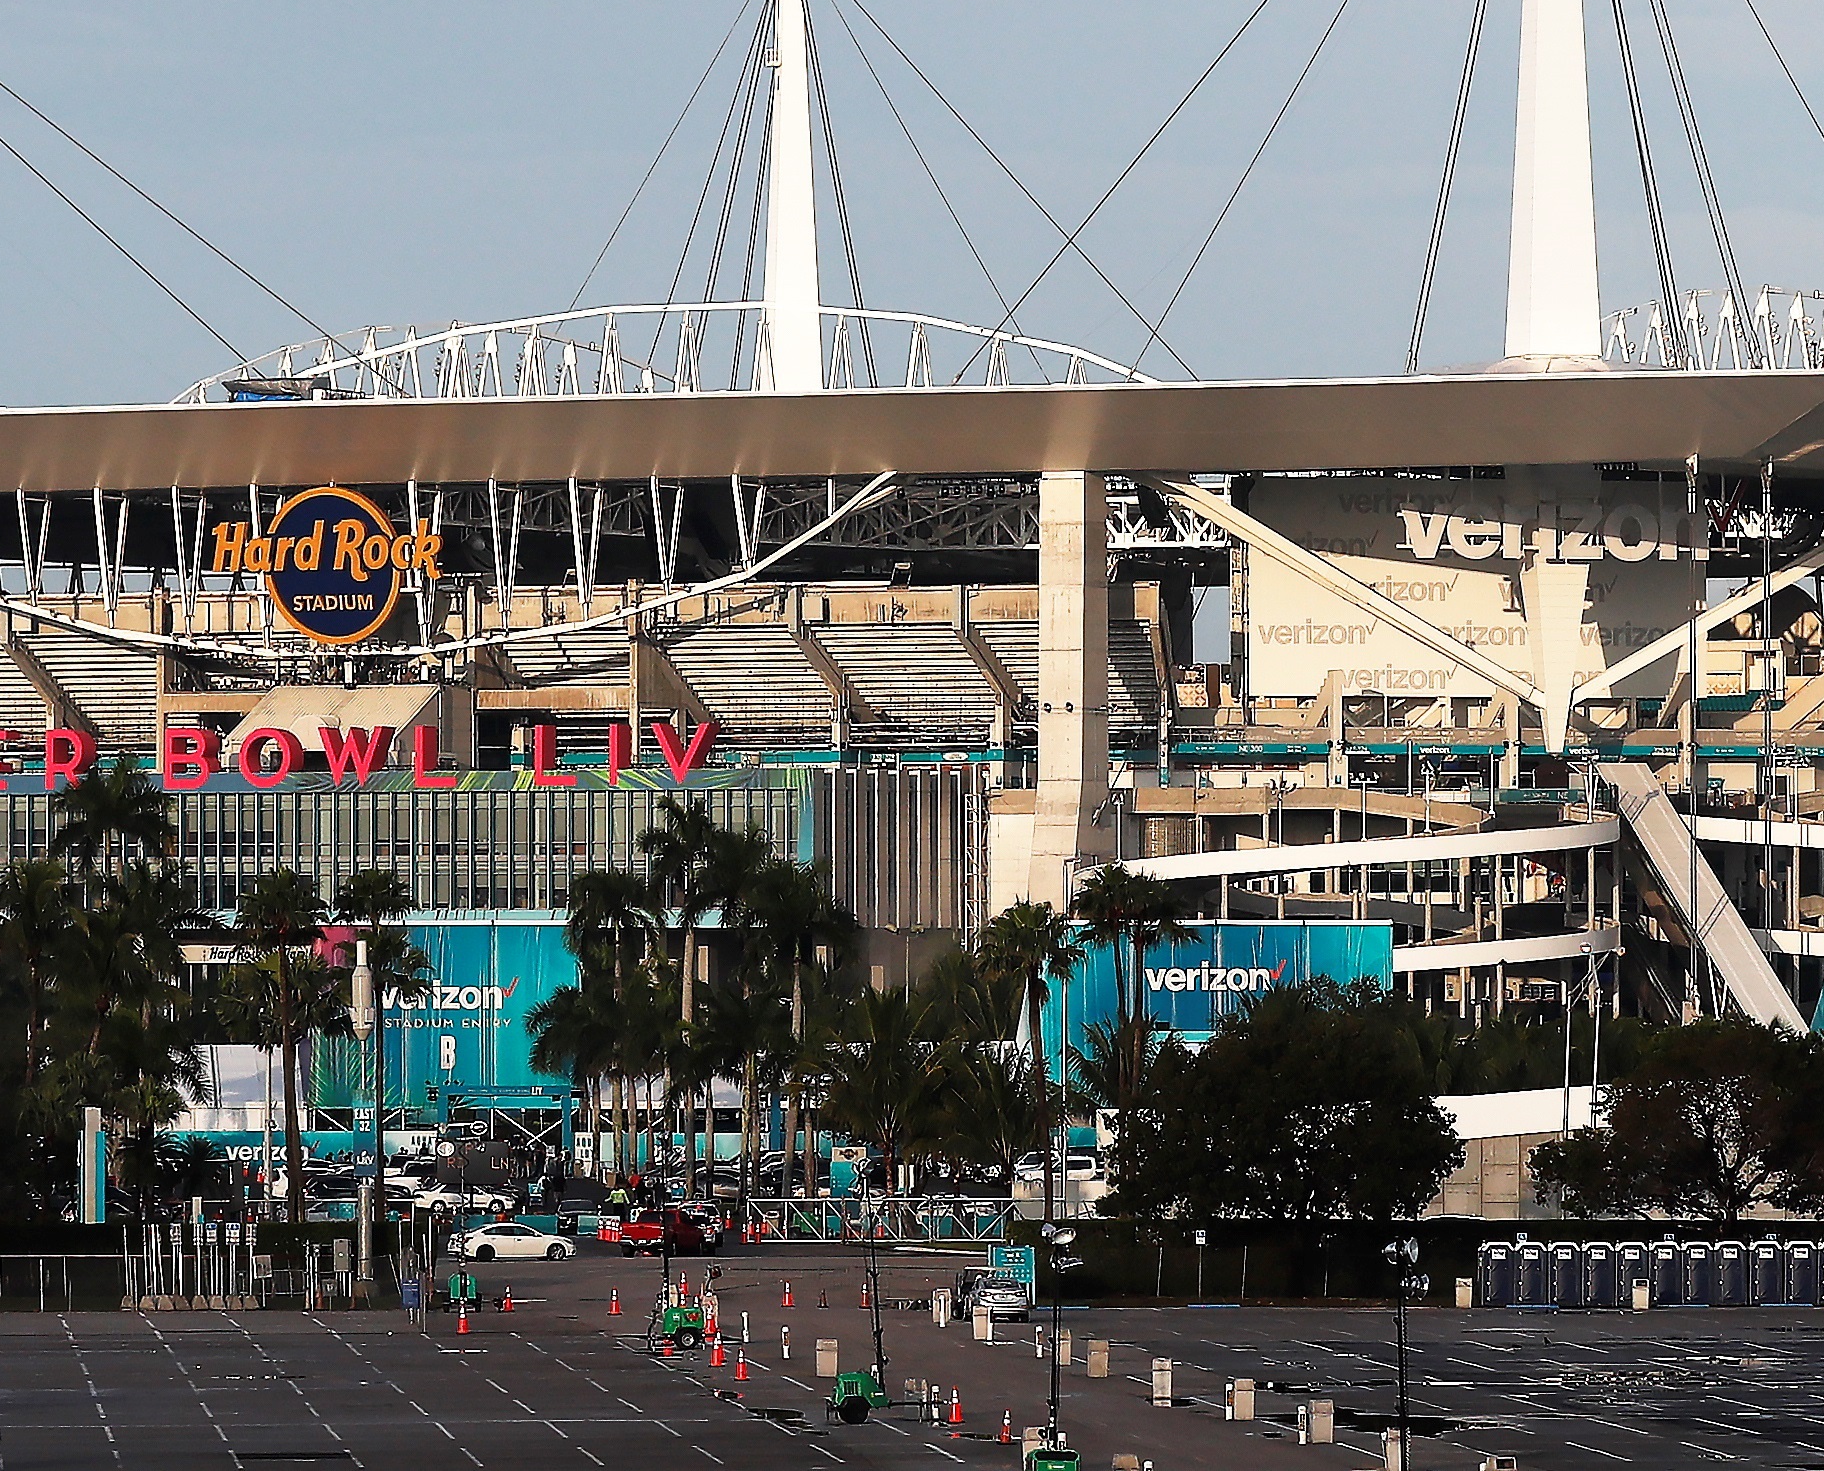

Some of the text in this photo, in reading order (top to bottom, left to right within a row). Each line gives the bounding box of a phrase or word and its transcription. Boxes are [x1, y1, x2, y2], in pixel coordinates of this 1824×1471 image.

[1400, 500, 1710, 562] verizon
[211, 517, 444, 582] Hard Rock
[292, 593, 375, 613] STADIUM
[1257, 618, 1366, 645] verizon
[1341, 663, 1446, 690] verizon
[162, 725, 457, 790] BOWL
[534, 721, 719, 787] LIV
[1419, 745, 1452, 755] verizon
[1144, 960, 1271, 993] verizon
[384, 1017, 512, 1029] STADIUM ENTRY
[439, 1035, 457, 1070] B
[353, 1108, 375, 1120] EAST
[358, 1120, 371, 1133] 32
